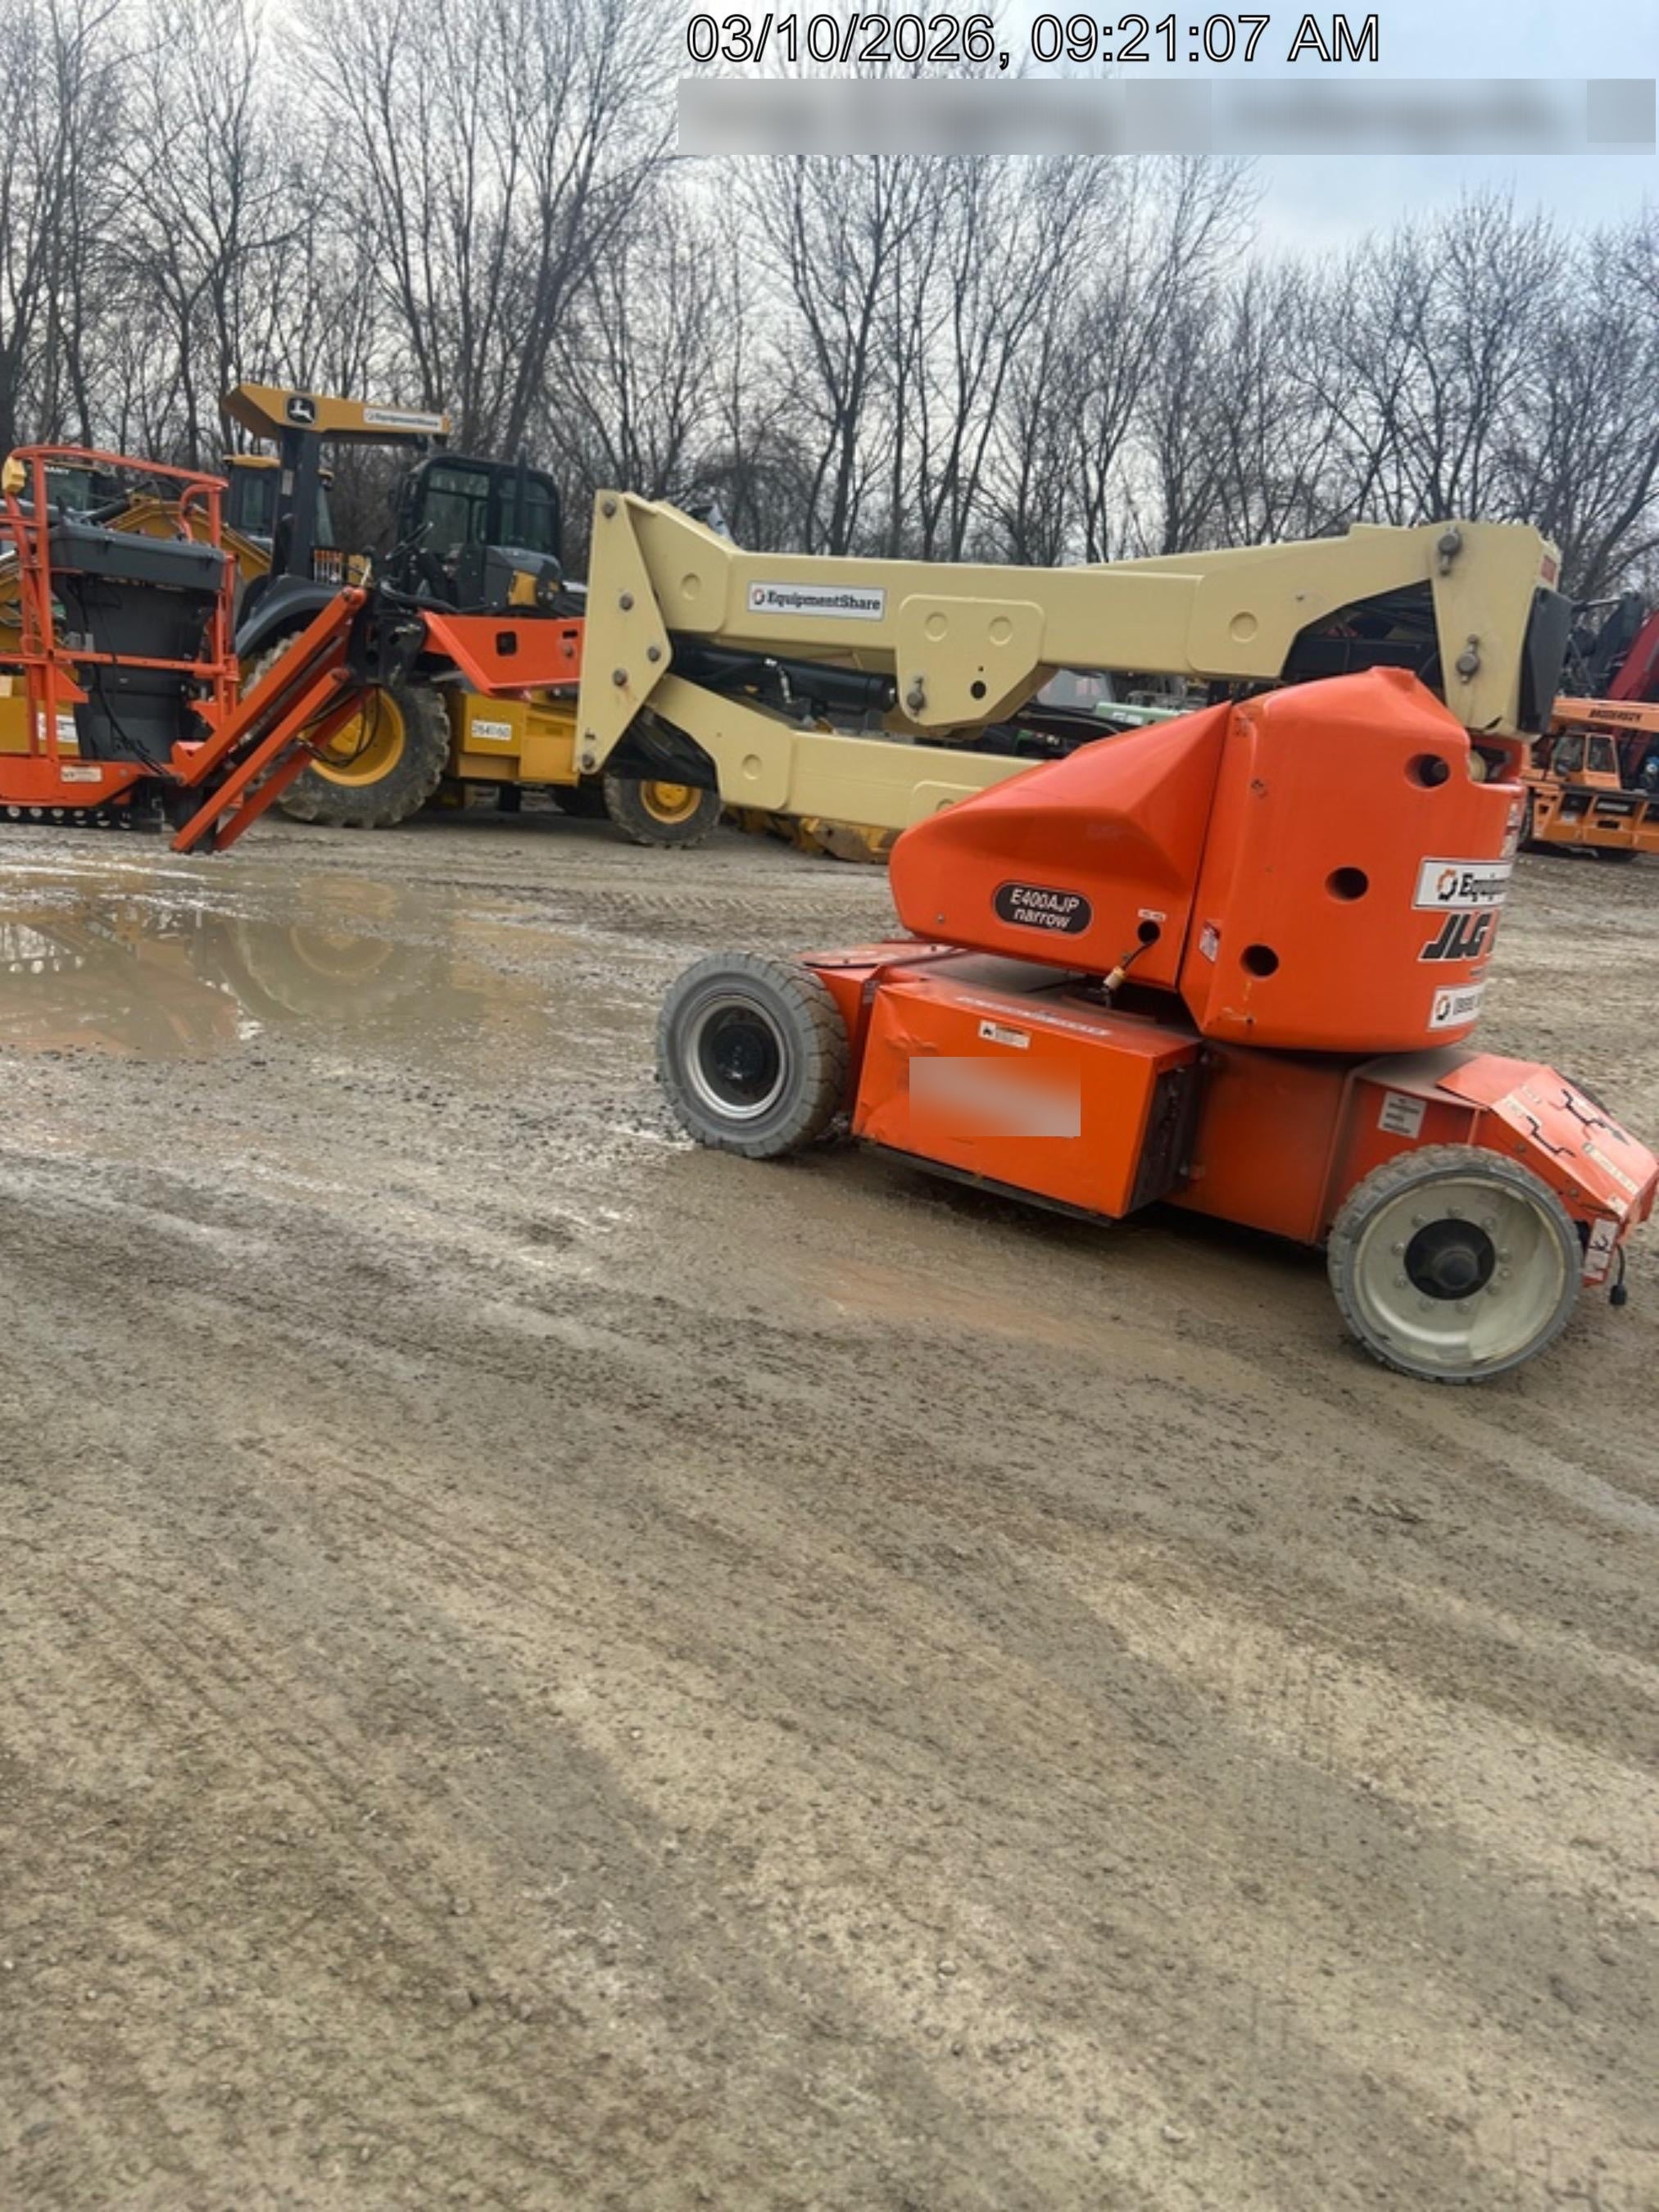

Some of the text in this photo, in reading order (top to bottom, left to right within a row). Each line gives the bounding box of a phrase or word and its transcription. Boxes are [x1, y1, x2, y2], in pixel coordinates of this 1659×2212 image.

[767, 589, 882, 610] EquipmentShare
[1009, 888, 1080, 913] E400AJP
[1013, 907, 1072, 928] narrow
[1421, 913, 1493, 959] JLG
